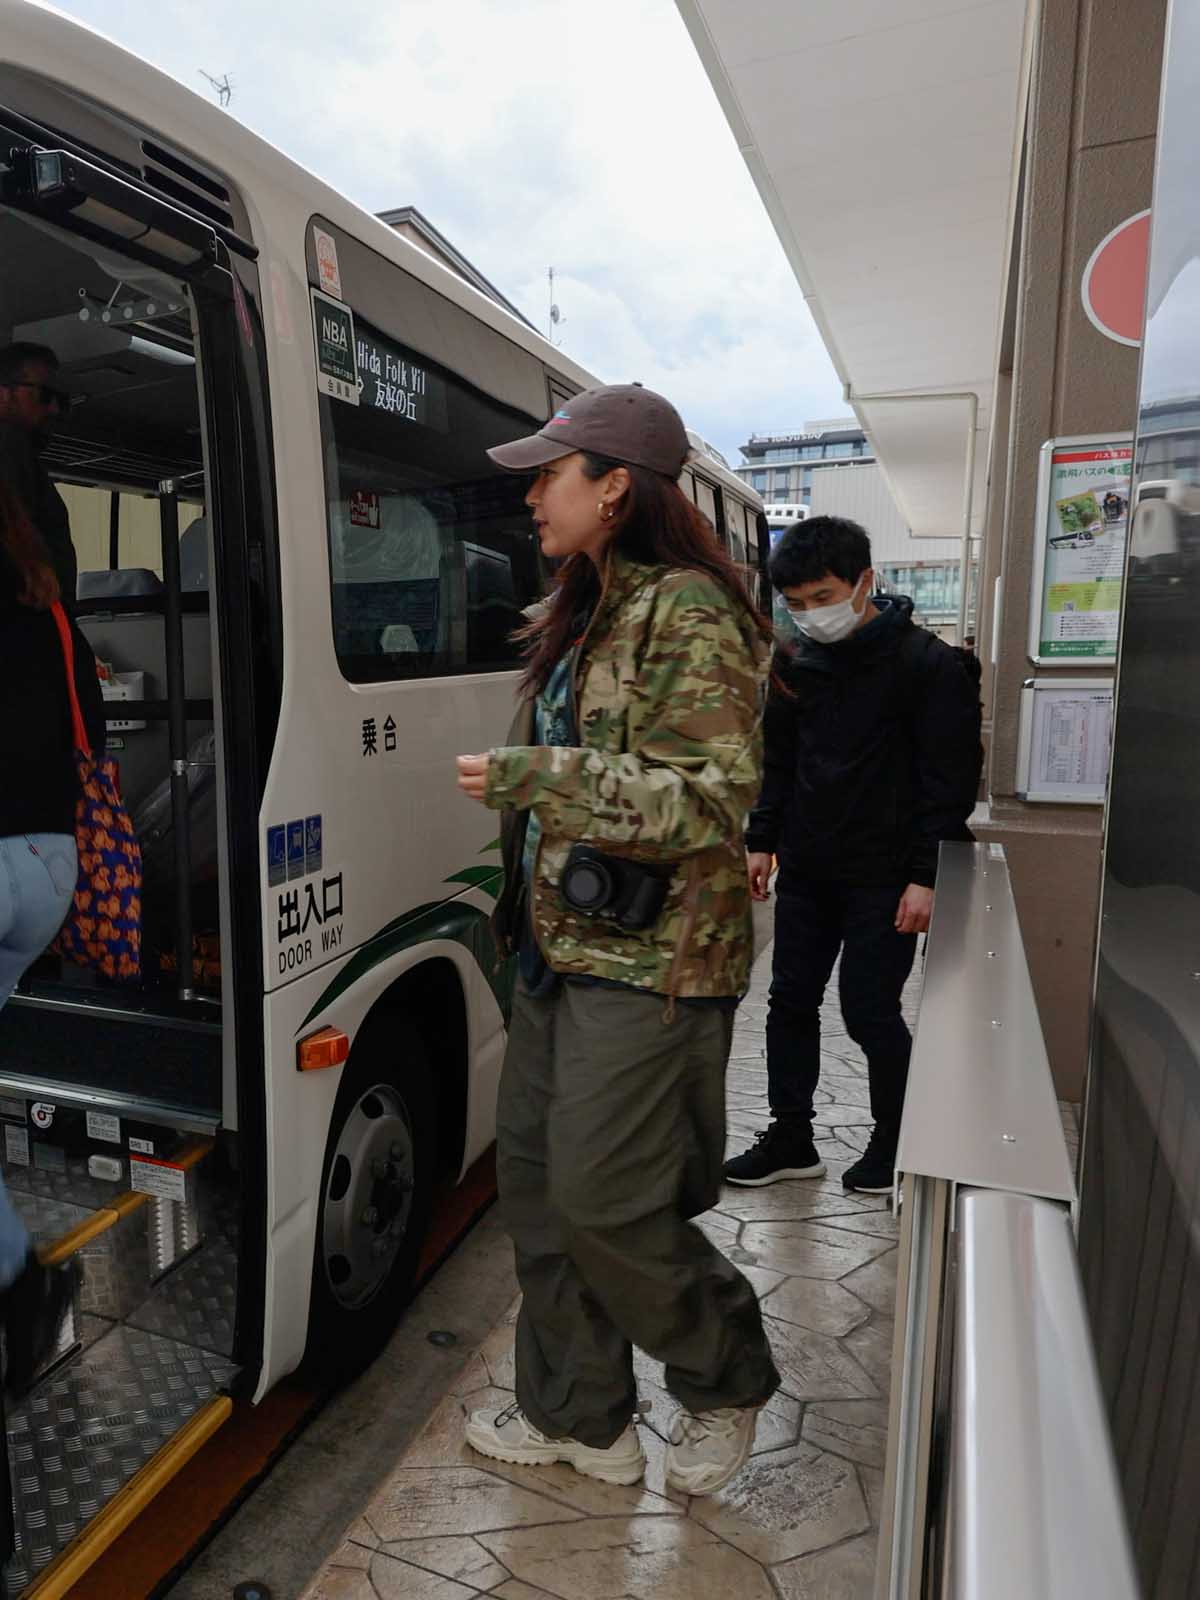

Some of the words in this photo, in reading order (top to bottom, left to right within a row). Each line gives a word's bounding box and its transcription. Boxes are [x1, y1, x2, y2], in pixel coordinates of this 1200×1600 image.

[322, 317, 348, 348] NBA
[357, 340, 381, 375] Hida
[385, 354, 407, 388] Folk
[411, 366, 425, 396] Vil
[375, 379, 417, 421] 友好の丘
[362, 714, 397, 756] 乗合
[278, 872, 343, 943] 出入口
[278, 939, 313, 974] DOOR
[321, 925, 343, 953] WAY
